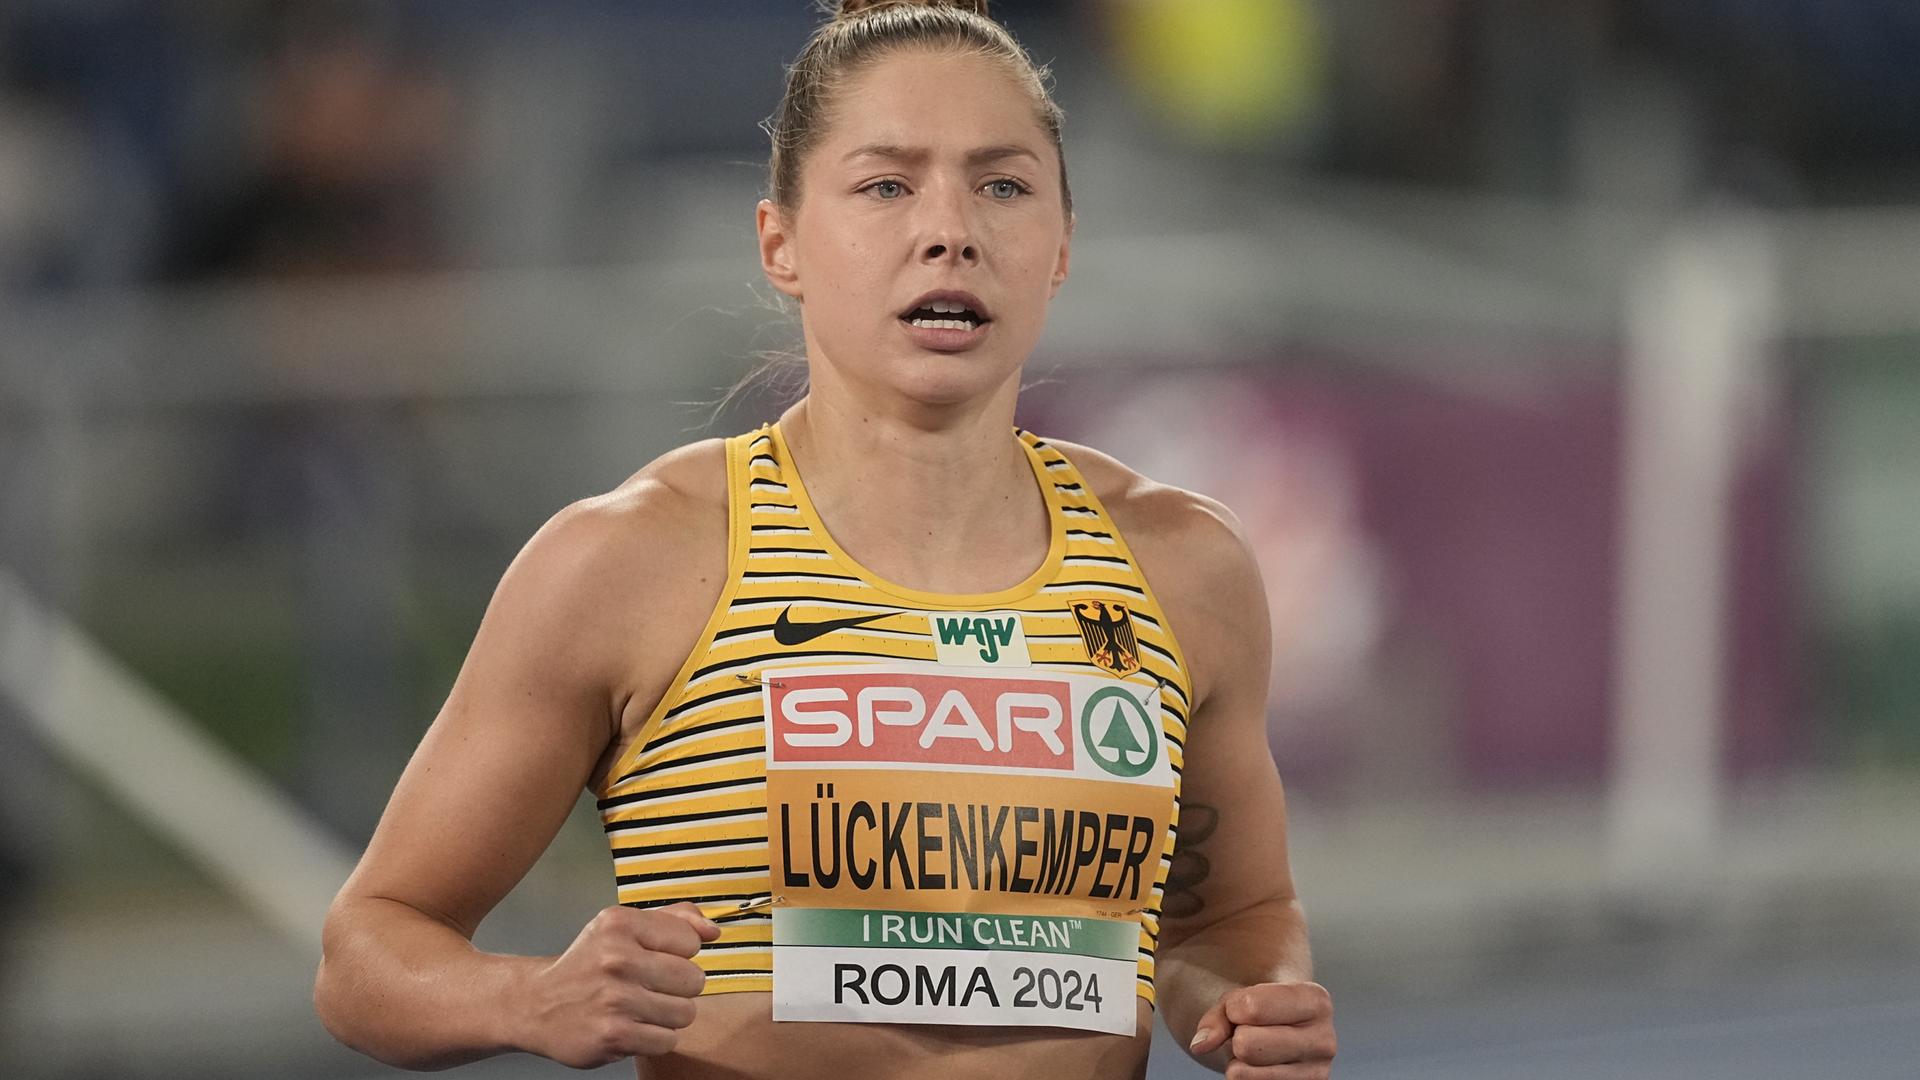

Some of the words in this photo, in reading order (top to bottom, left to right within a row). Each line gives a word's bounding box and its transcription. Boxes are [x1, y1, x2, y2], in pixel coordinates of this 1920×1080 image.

[781, 686, 1065, 756] SPAR
[781, 783, 1155, 900] LÜCKENKEMPER
[862, 914, 870, 943] I
[881, 915, 962, 944] RUN
[833, 963, 1000, 1008] ROMA
[1012, 967, 1103, 1014] 2024
